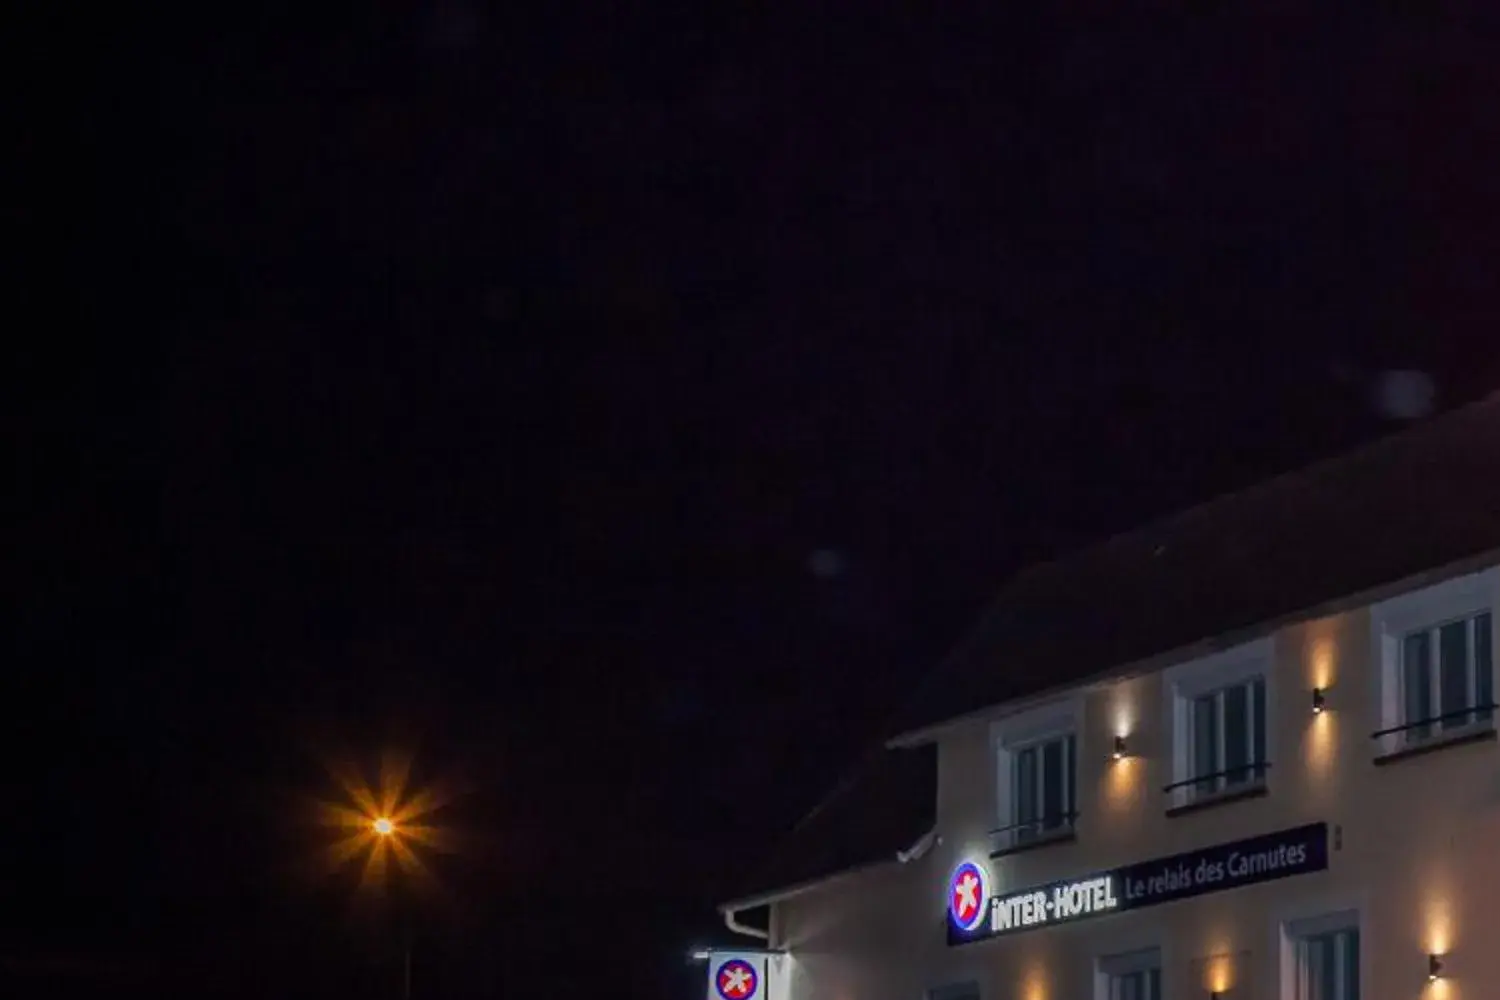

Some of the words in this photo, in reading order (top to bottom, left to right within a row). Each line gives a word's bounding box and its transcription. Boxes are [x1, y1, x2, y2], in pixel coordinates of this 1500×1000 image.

[1124, 876, 1146, 900] Le
[1147, 862, 1193, 895] relais
[1194, 857, 1225, 885] des
[1226, 843, 1308, 878] Carnutes
